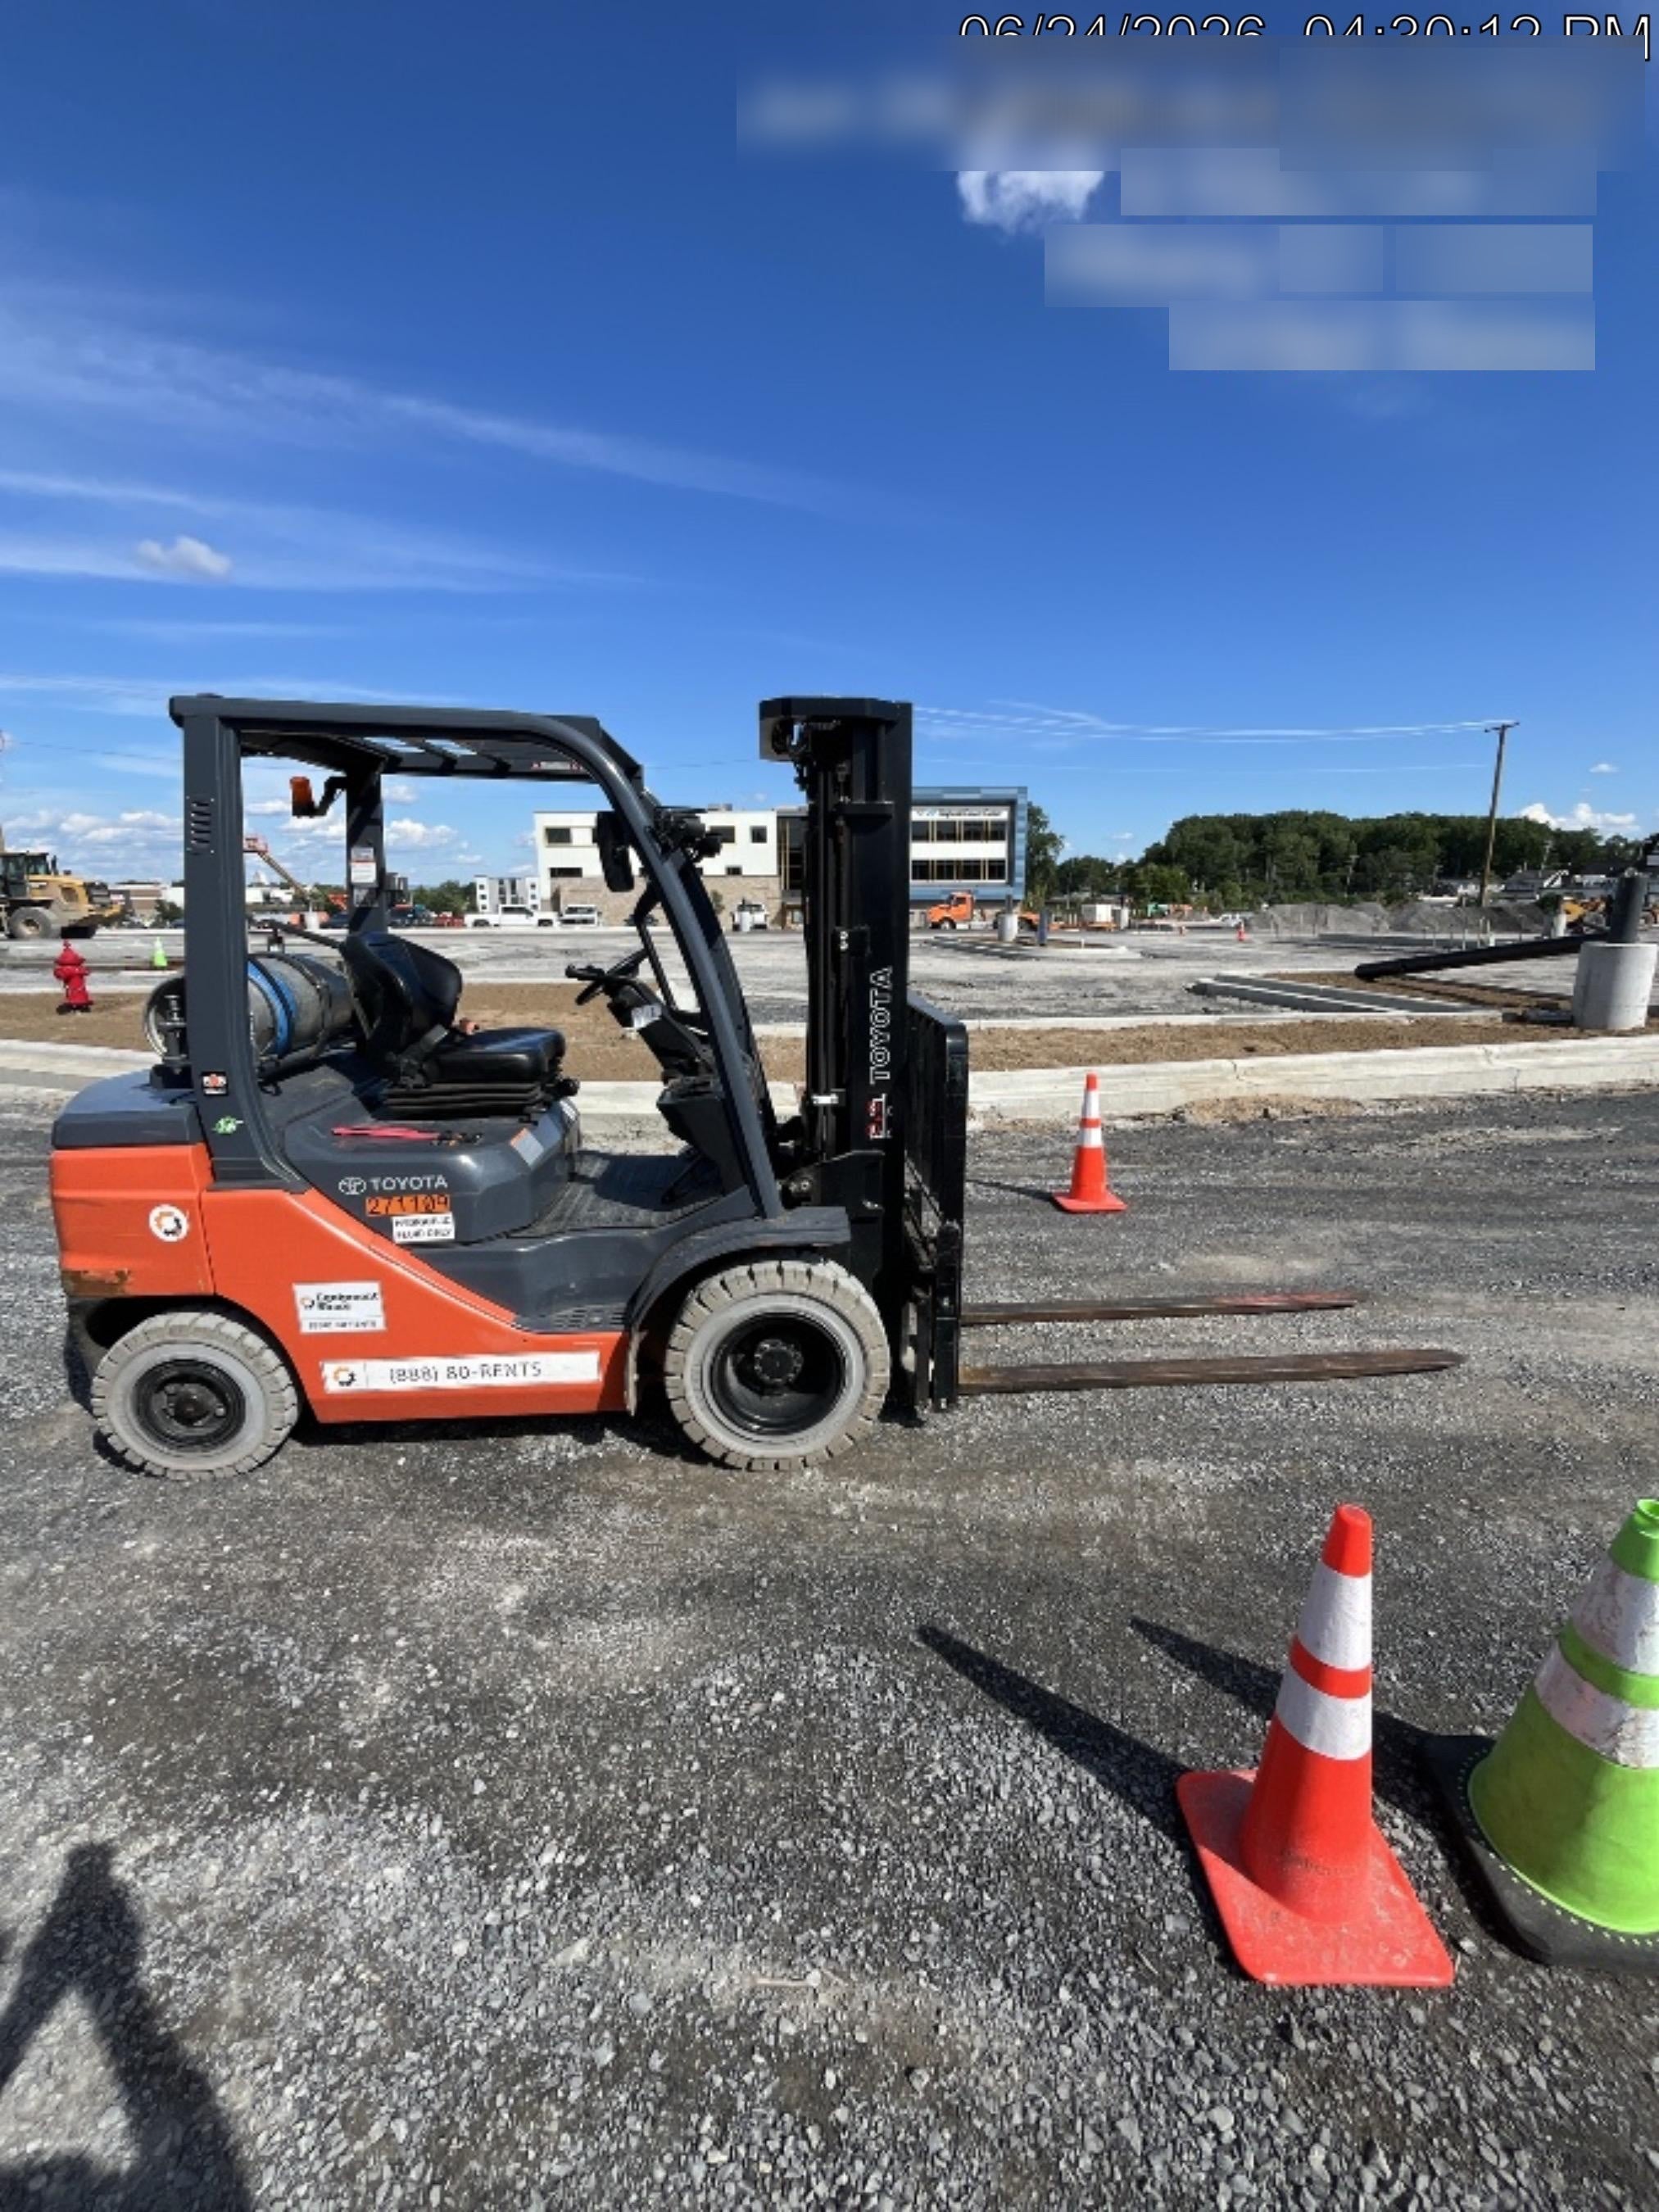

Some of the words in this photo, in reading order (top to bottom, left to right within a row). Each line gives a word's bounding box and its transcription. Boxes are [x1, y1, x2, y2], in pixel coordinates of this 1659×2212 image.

[869, 966, 893, 1086] TOYOTA
[370, 1175, 448, 1191] TOYOTA
[446, 1362, 542, 1380] 80-RENTS
